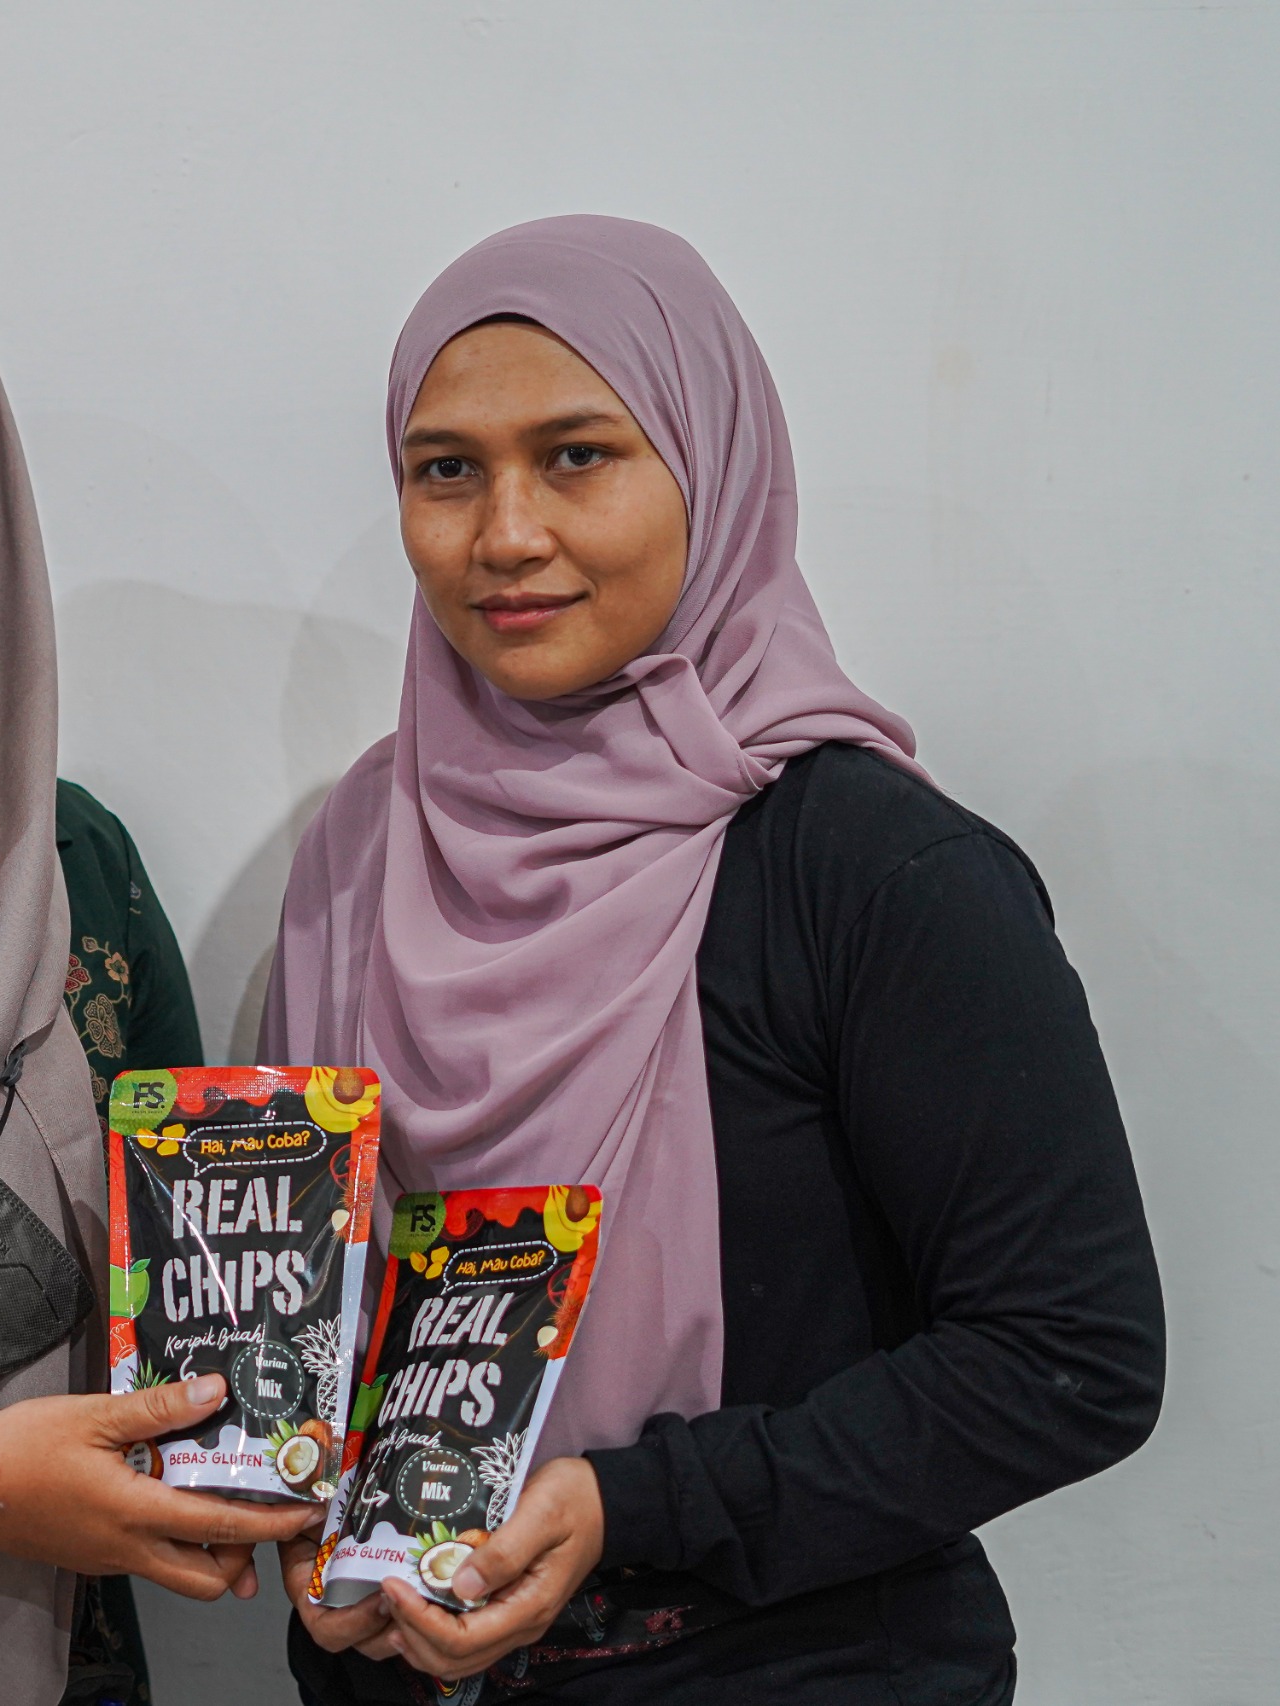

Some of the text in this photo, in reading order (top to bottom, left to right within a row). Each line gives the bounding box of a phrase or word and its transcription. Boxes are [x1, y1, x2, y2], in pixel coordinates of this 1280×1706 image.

[200, 1130, 311, 1156] Hai, Mau Coba?
[172, 1175, 303, 1240] REAL
[455, 1249, 545, 1277] Hai, Mau Coba?
[162, 1250, 305, 1323] CHIPS
[407, 1292, 515, 1353] REAL
[164, 1324, 264, 1360] Keripik Buah
[254, 1355, 288, 1371] Varian
[257, 1379, 283, 1400] Mix
[377, 1359, 502, 1428] CHIPS
[395, 1428, 443, 1450] Buah
[169, 1451, 263, 1468] BEBAS GLUTEN
[422, 1460, 459, 1474] Varian
[421, 1481, 452, 1501] Mix
[360, 1546, 406, 1563] GLUTEN
